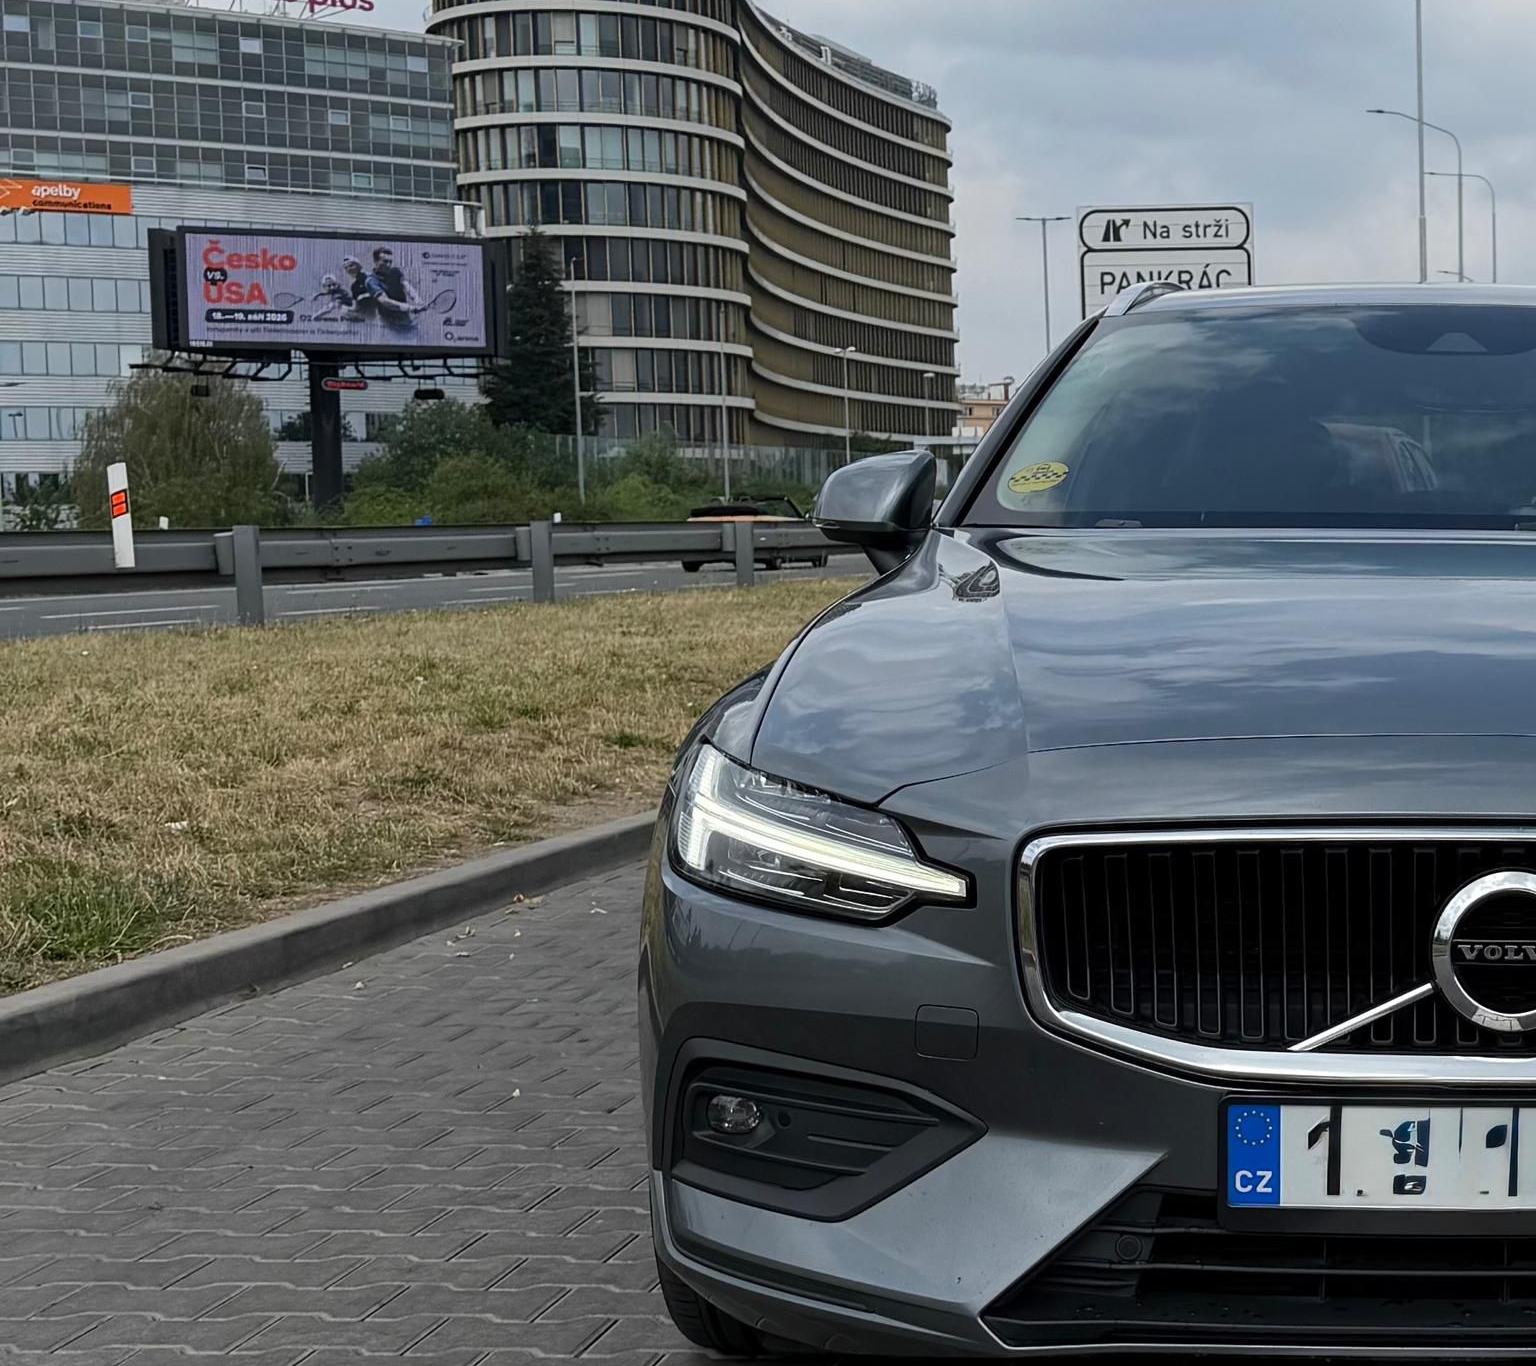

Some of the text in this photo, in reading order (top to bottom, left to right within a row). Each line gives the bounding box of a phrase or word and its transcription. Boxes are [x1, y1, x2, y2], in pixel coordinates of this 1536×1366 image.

[31, 182, 81, 201] apelby
[1143, 218, 1230, 240] Na strži
[202, 238, 298, 273] Česko
[205, 270, 226, 281] vs.
[203, 281, 269, 306] USA
[1234, 1169, 1273, 1195] CZ
